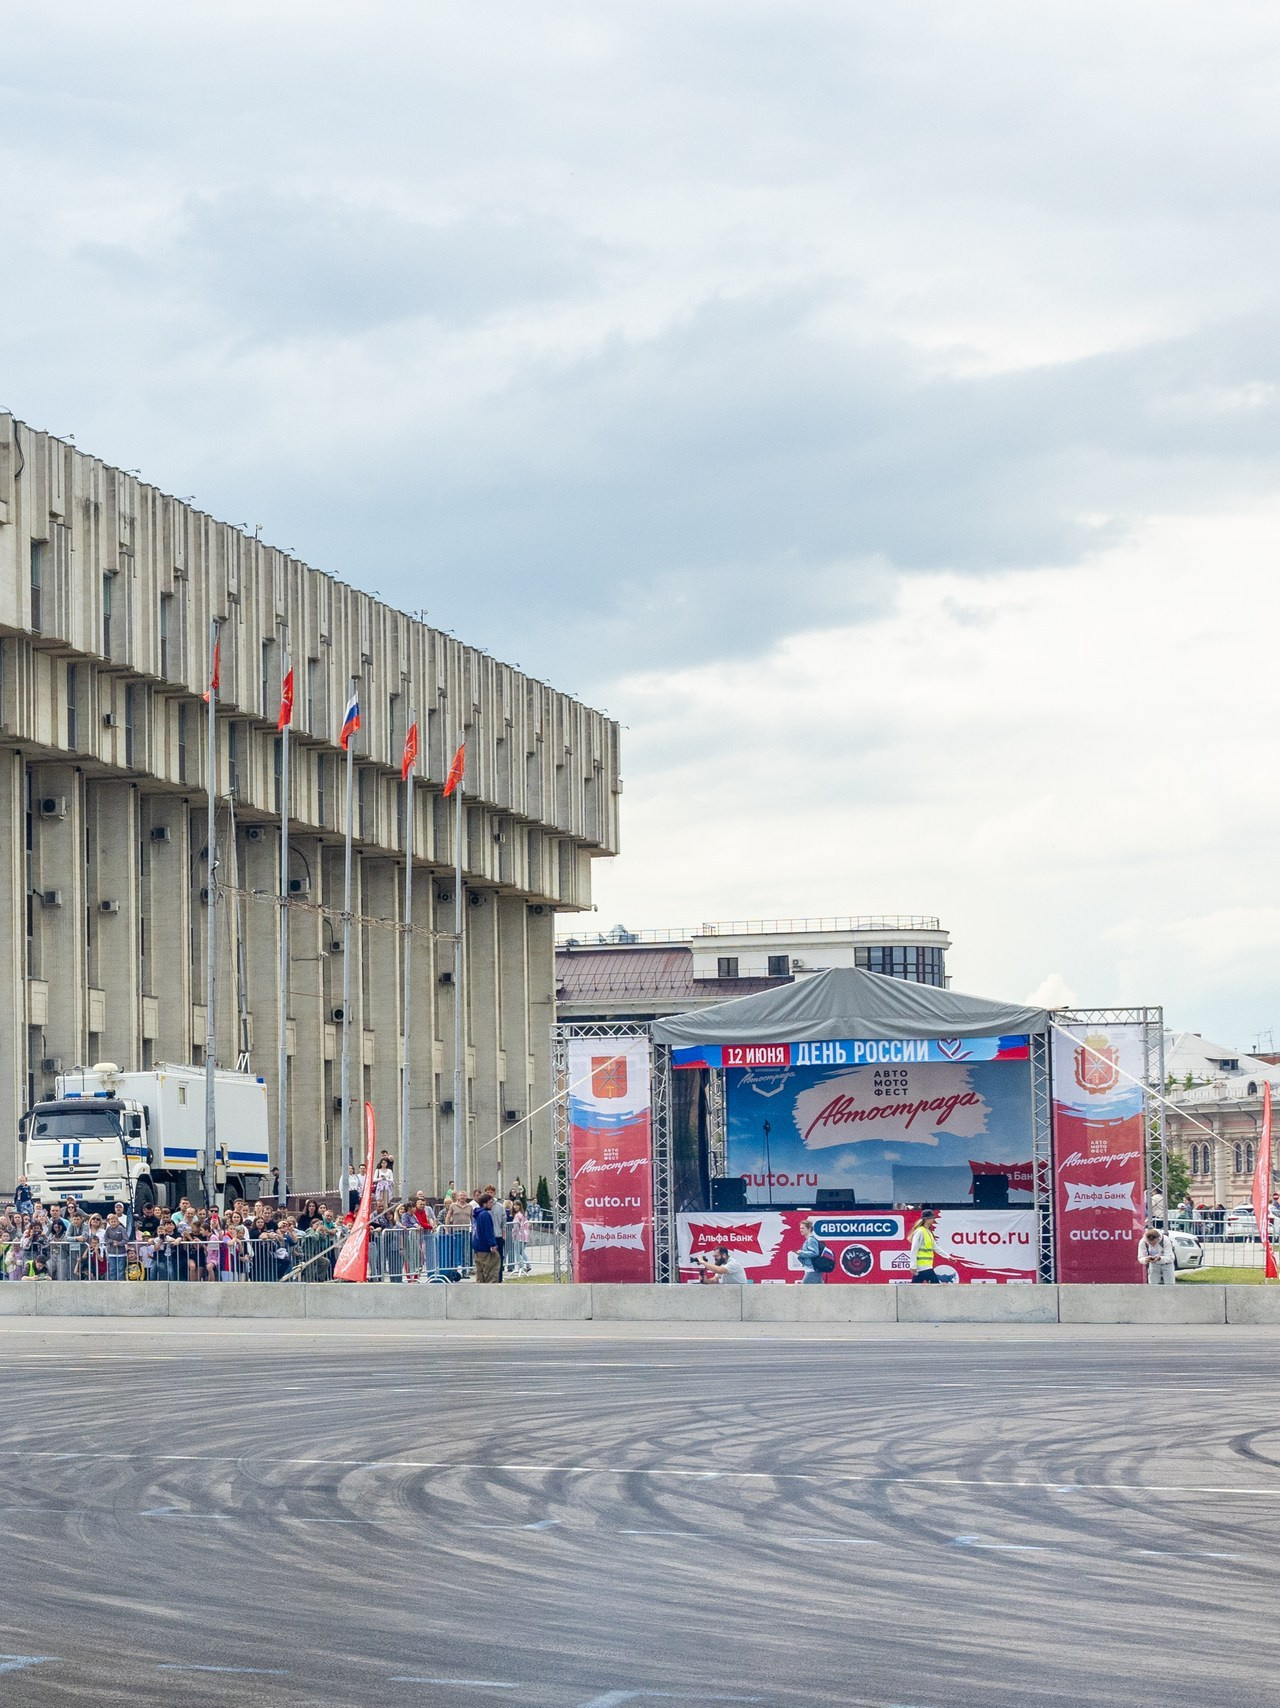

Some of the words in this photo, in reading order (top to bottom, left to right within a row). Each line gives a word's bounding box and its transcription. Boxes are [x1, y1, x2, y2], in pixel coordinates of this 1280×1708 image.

[728, 1048, 743, 1064] 12
[746, 1047, 785, 1064] ИЮНЯ
[796, 1042, 847, 1065] ДЕНЬ
[854, 1040, 929, 1063] РОССИИ
[874, 1070, 908, 1078] АВТО
[874, 1079, 908, 1087] МОТО
[874, 1088, 909, 1096] ФЕСТ
[805, 1091, 980, 1139] Автострада
[1057, 1150, 1141, 1173] Автострада
[574, 1157, 649, 1180] Автострада
[739, 1171, 818, 1187] auto.ru
[1013, 1171, 1033, 1181] Бан
[584, 1195, 641, 1208] auto.ru
[1073, 1192, 1103, 1201] Альфа
[1104, 1191, 1126, 1199] Банк
[820, 1222, 891, 1233] АВТОКЛАСС
[590, 1232, 616, 1241] Альфа
[616, 1232, 637, 1240] Банк
[698, 1233, 729, 1243] Альфа
[730, 1233, 753, 1242] Банк
[951, 1229, 1030, 1245] auto.ru
[1069, 1228, 1133, 1241] auto.ru
[891, 1260, 911, 1269] БЕТО
